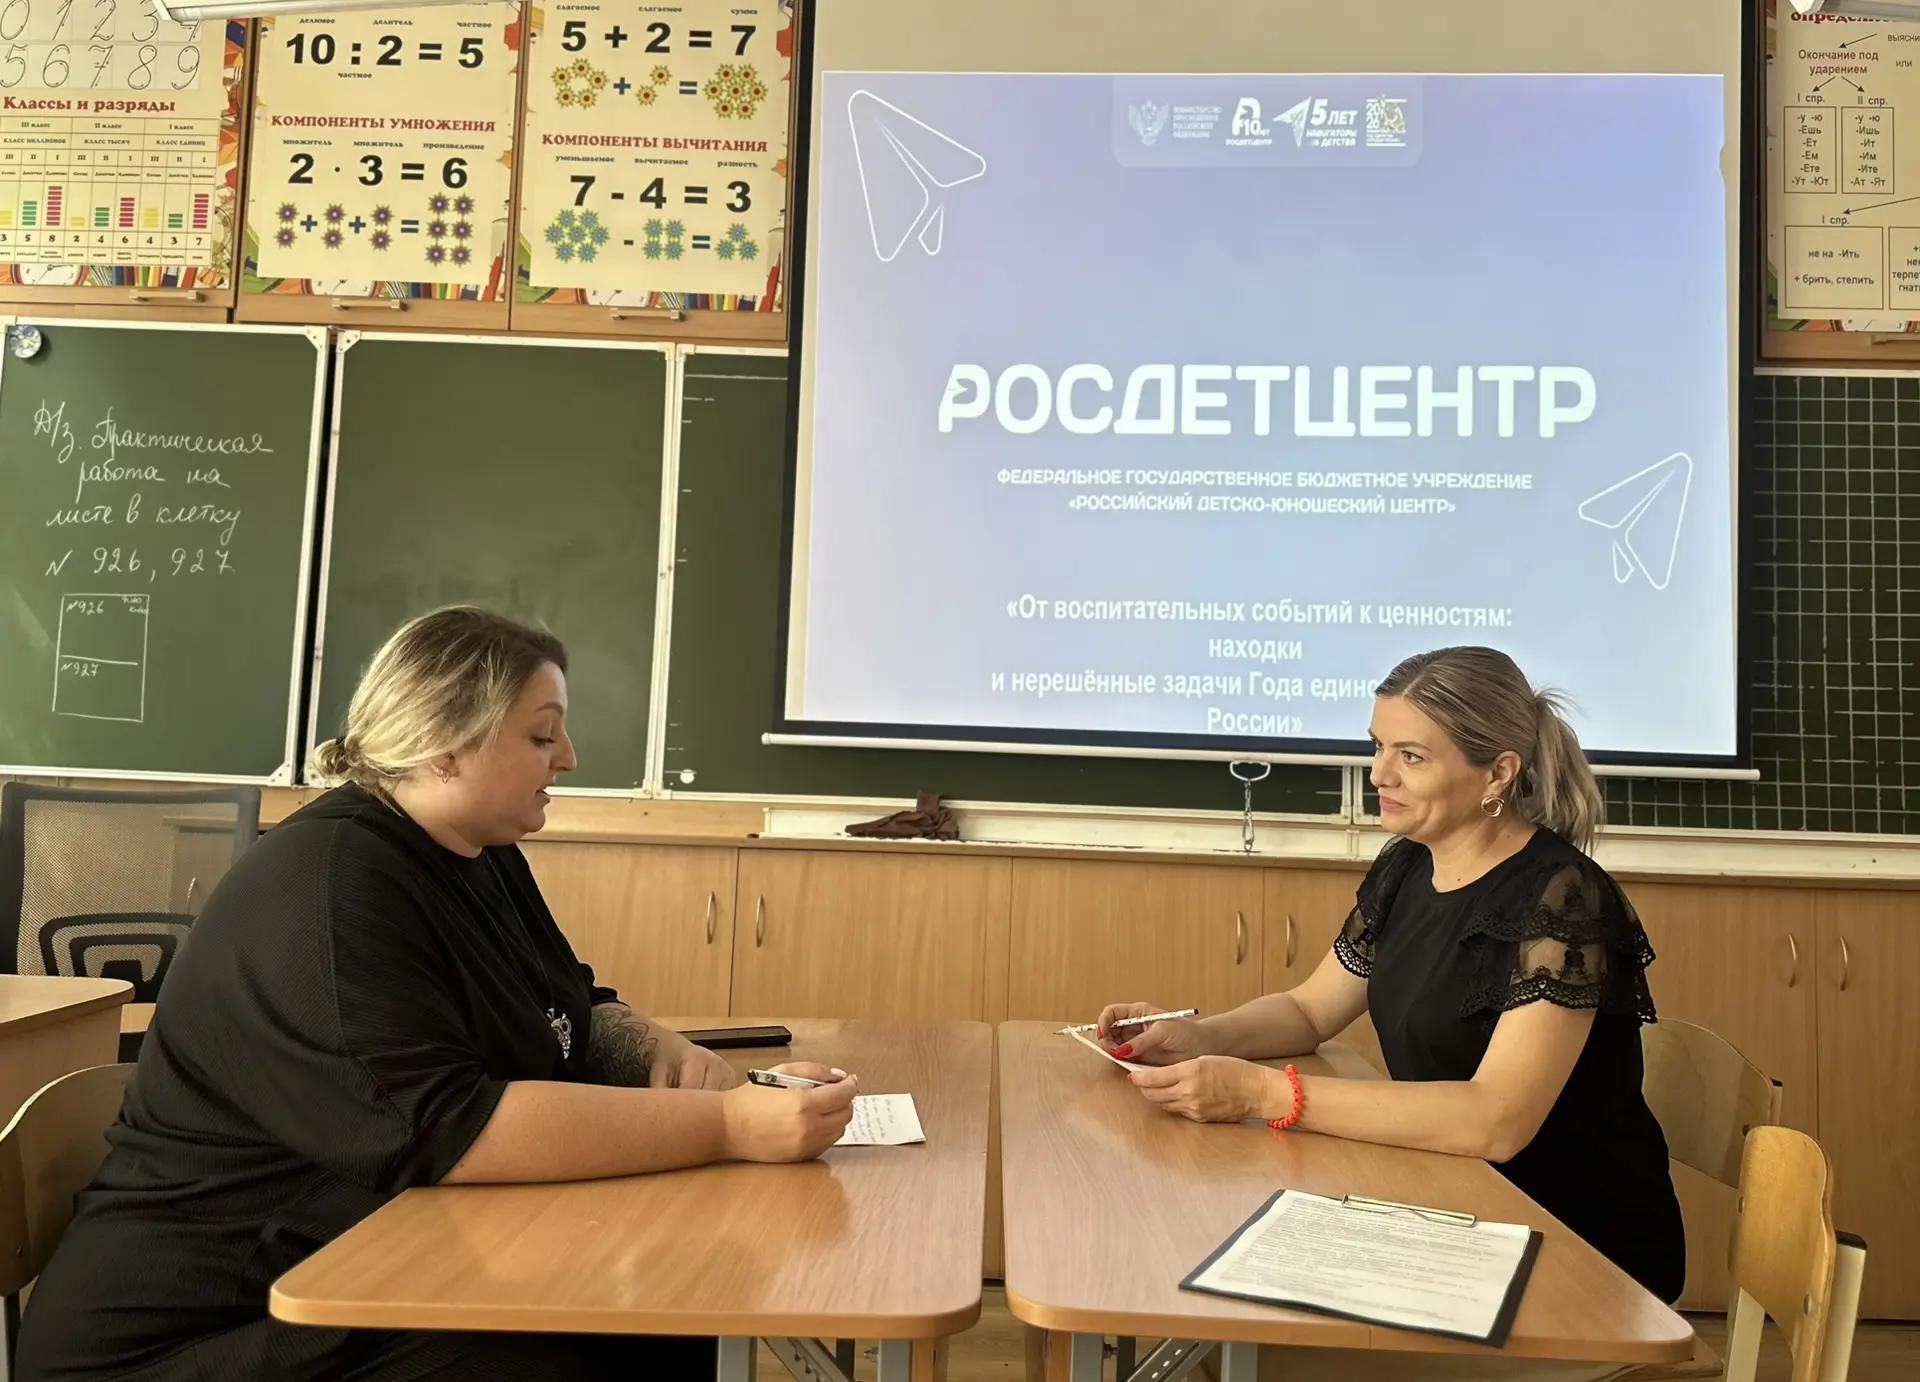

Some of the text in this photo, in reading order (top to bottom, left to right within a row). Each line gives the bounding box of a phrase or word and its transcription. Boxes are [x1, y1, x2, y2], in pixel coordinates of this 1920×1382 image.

[299, 17, 336, 25] делимое
[561, 21, 587, 52] 5
[644, 22, 671, 53] 2
[730, 25, 756, 56] 7
[286, 33, 335, 65] 10
[376, 35, 403, 66] 2
[458, 37, 484, 69] 5
[1798, 49, 1879, 61] Окончание под
[0, 44, 200, 90] 5 6 7 8 9
[1809, 66, 1867, 76] ударением
[3, 97, 175, 113] Классы и разряды
[1805, 95, 1825, 105] спр.
[1868, 97, 1888, 107] спр.
[1310, 98, 1358, 126] 5 ЛЕТ
[1366, 103, 1380, 116] 20
[271, 115, 496, 132] КОМПОНЕНТЫ УМНОЖЕНИЯ
[1366, 117, 1380, 129] 26
[1798, 125, 1822, 134] -Ешь
[1856, 125, 1880, 135] -Ишь
[353, 140, 404, 148] множитель
[423, 142, 485, 151] произведение
[542, 134, 768, 152] КОМПОНЕНТЫ ВЫЧИТАНИЯ
[1802, 139, 1817, 147] -Ет
[1860, 139, 1875, 147] -Ит
[555, 155, 758, 169] уменьшаемое вычитаемое разность
[1801, 152, 1818, 160] -Ем
[1859, 152, 1876, 160] -Им
[288, 153, 315, 184] 2
[358, 155, 383, 186] 3
[442, 157, 468, 189] 6
[1800, 164, 1820, 172] -Ете
[1858, 165, 1878, 173] -Ите
[1792, 177, 1829, 186] -Ут -Ют
[1850, 178, 1885, 187] -Ат -Ят
[570, 175, 596, 207] 7
[639, 177, 667, 209] 4
[725, 180, 752, 213] 3
[1830, 216, 1850, 226] спр.
[25, 234, 31, 242] 5
[49, 235, 55, 243] 8
[73, 235, 80, 243] 2
[97, 235, 104, 244] 4
[122, 236, 129, 244] 6
[146, 236, 153, 245] 4
[170, 237, 178, 245] 3
[196, 237, 202, 246] 7
[1808, 250, 1819, 258] не
[1838, 250, 1860, 259] -Ить
[1802, 274, 1874, 286] брить, стелить
[938, 363, 1597, 438] РОСДЕТЦЕНТР
[91, 406, 274, 460] Практическая
[76, 457, 231, 504] работа на
[997, 469, 1532, 489] ФЕДЕРАЛЬНОЕ ГОСУДАРСТВЕННОЕ БЮДЖЕТНОЕ УЧРЕЖДЕНИЕ
[1069, 491, 1456, 514] «РОССИЙСКИЙ ДЕТСКО-ЮНОШЕСКИЙ ЦЕНТР»
[46, 505, 115, 527] листе
[155, 505, 242, 546] клетку
[1006, 594, 1512, 628] «От воспитательных событий к ценностям:
[1209, 638, 1302, 663] находки
[991, 672, 1004, 691] и
[1011, 669, 1156, 698] нерешённые
[1162, 674, 1241, 698] задачи
[1249, 671, 1303, 701] Года
[1207, 707, 1303, 735] России»
